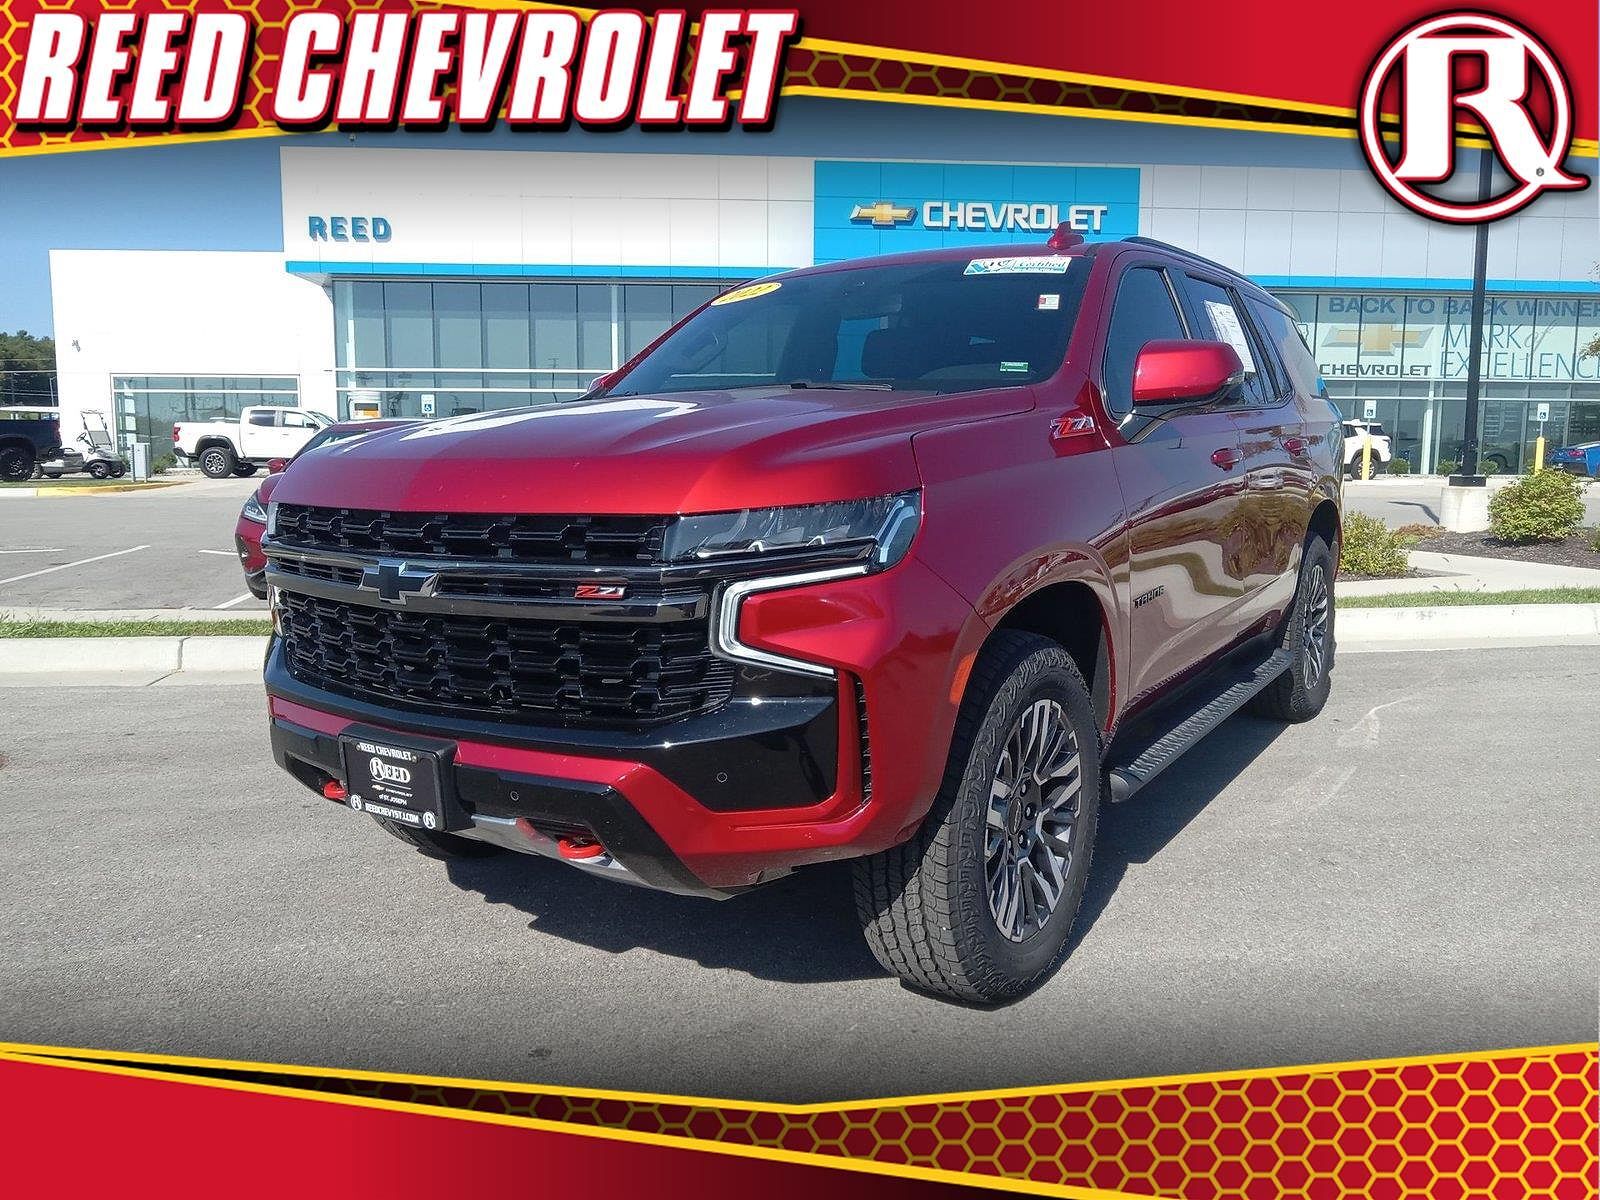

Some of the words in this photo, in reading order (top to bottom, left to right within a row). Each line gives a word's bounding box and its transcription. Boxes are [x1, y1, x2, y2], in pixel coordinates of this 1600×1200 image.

[922, 201, 1108, 232] CHEVROLET
[308, 215, 392, 243] REED
[1328, 297, 1396, 314] BACK
[1404, 298, 1435, 315] TO
[1522, 319, 1557, 355] of
[1319, 363, 1433, 377] CHEVROLET
[1439, 351, 1600, 378] EXELLENC
[1050, 416, 1095, 439] Z71
[574, 585, 627, 599] Z71
[1132, 585, 1165, 608] TAHOE
[360, 742, 375, 754] REED
[376, 745, 412, 761] CHEVROLET
[369, 757, 411, 783] REED
